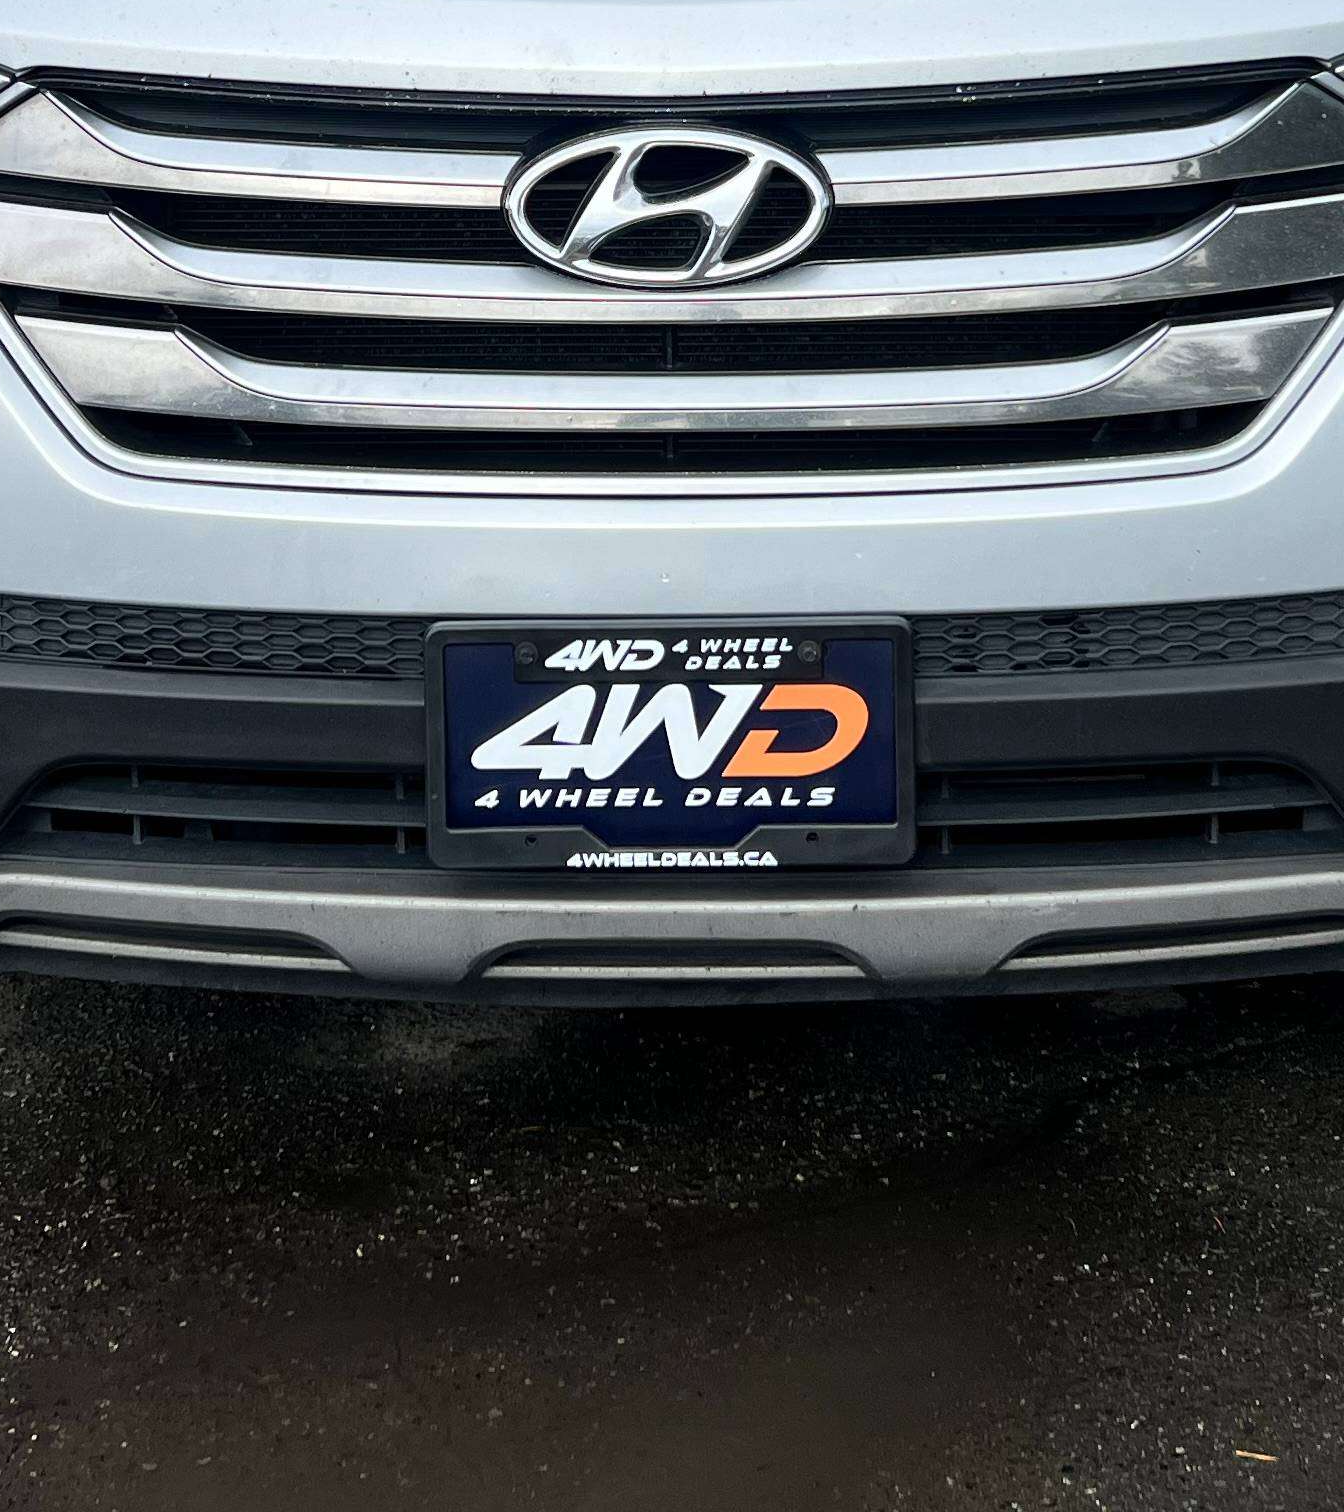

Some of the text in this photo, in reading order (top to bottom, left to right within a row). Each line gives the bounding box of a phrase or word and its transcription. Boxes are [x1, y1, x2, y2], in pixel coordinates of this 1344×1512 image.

[671, 637, 793, 653] 4 WHEEL
[544, 639, 665, 672] 4WD
[685, 654, 782, 671] DEALS
[471, 683, 869, 781] 4WD
[474, 787, 836, 808] 4 WHEEL DEALS
[566, 851, 778, 868] 4WHEELDEALS.CA
